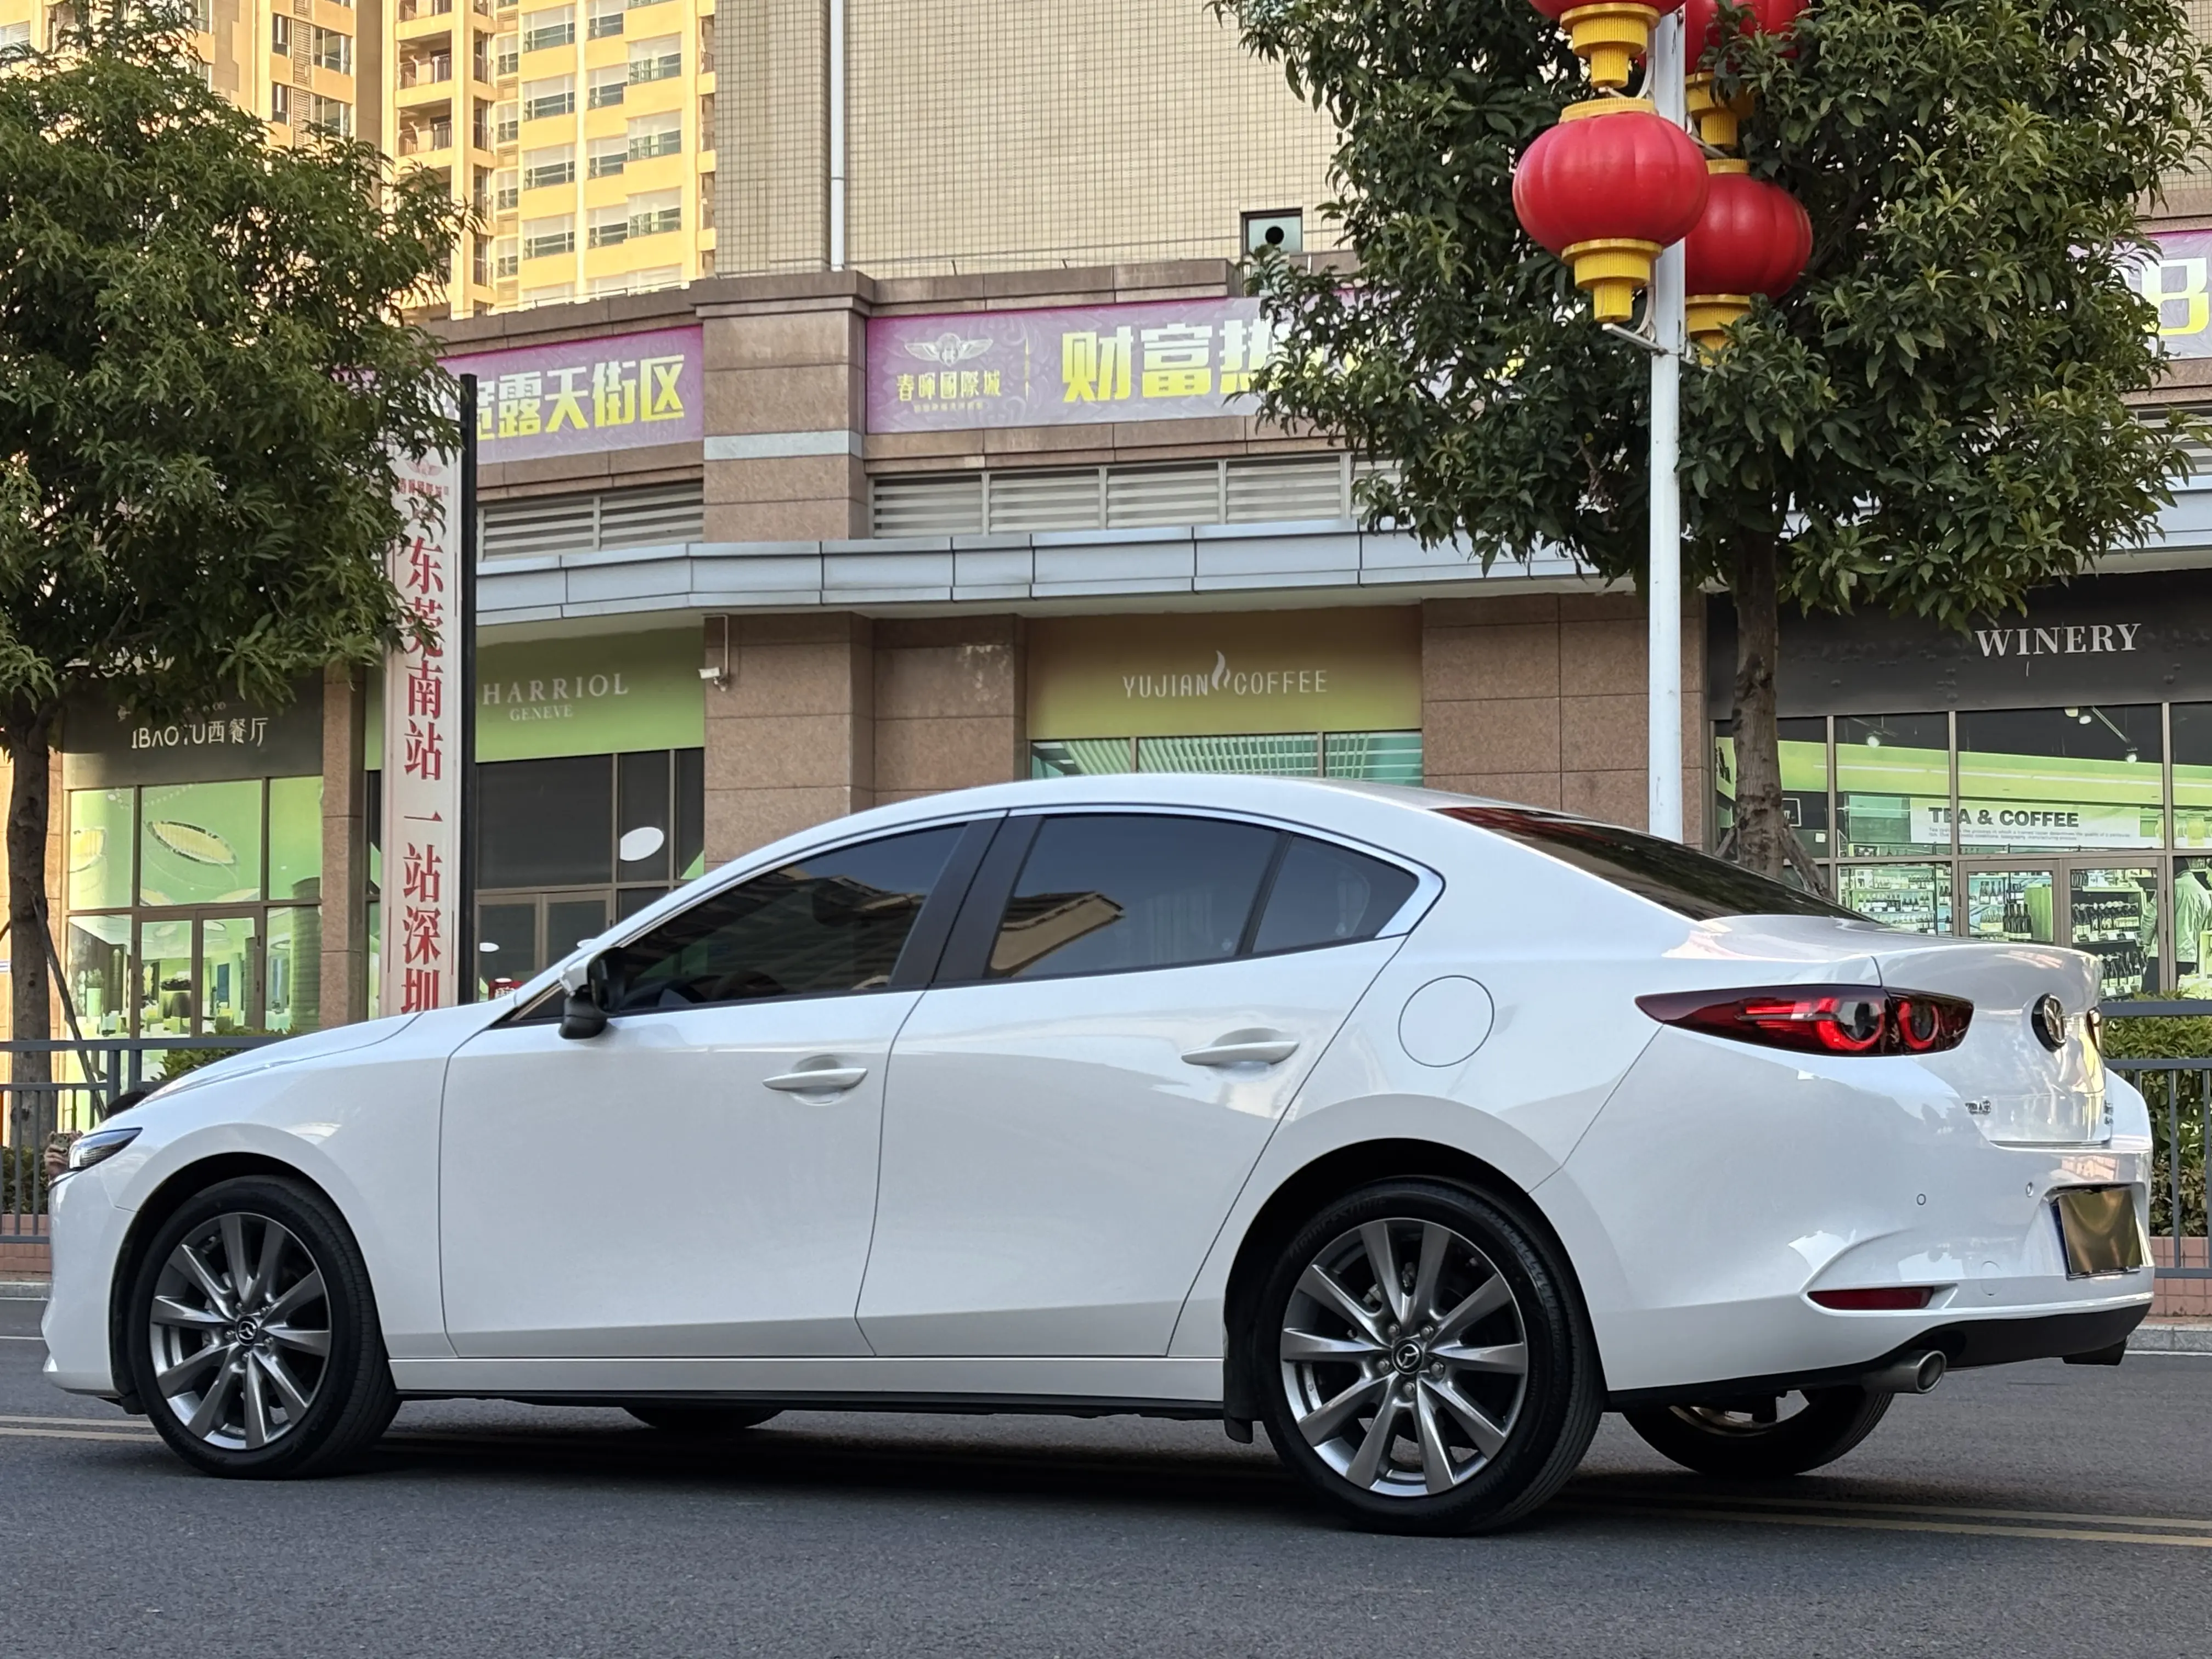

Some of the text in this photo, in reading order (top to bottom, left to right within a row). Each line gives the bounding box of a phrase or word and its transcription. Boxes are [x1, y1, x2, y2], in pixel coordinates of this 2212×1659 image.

[1975, 623, 2142, 657] WINERY
[482, 673, 630, 706] HARRIOL
[1122, 669, 1328, 698] YUJIAN COFFEE
[509, 704, 574, 721] GENEVE
[1928, 807, 2079, 828] TEA & COFFEE
